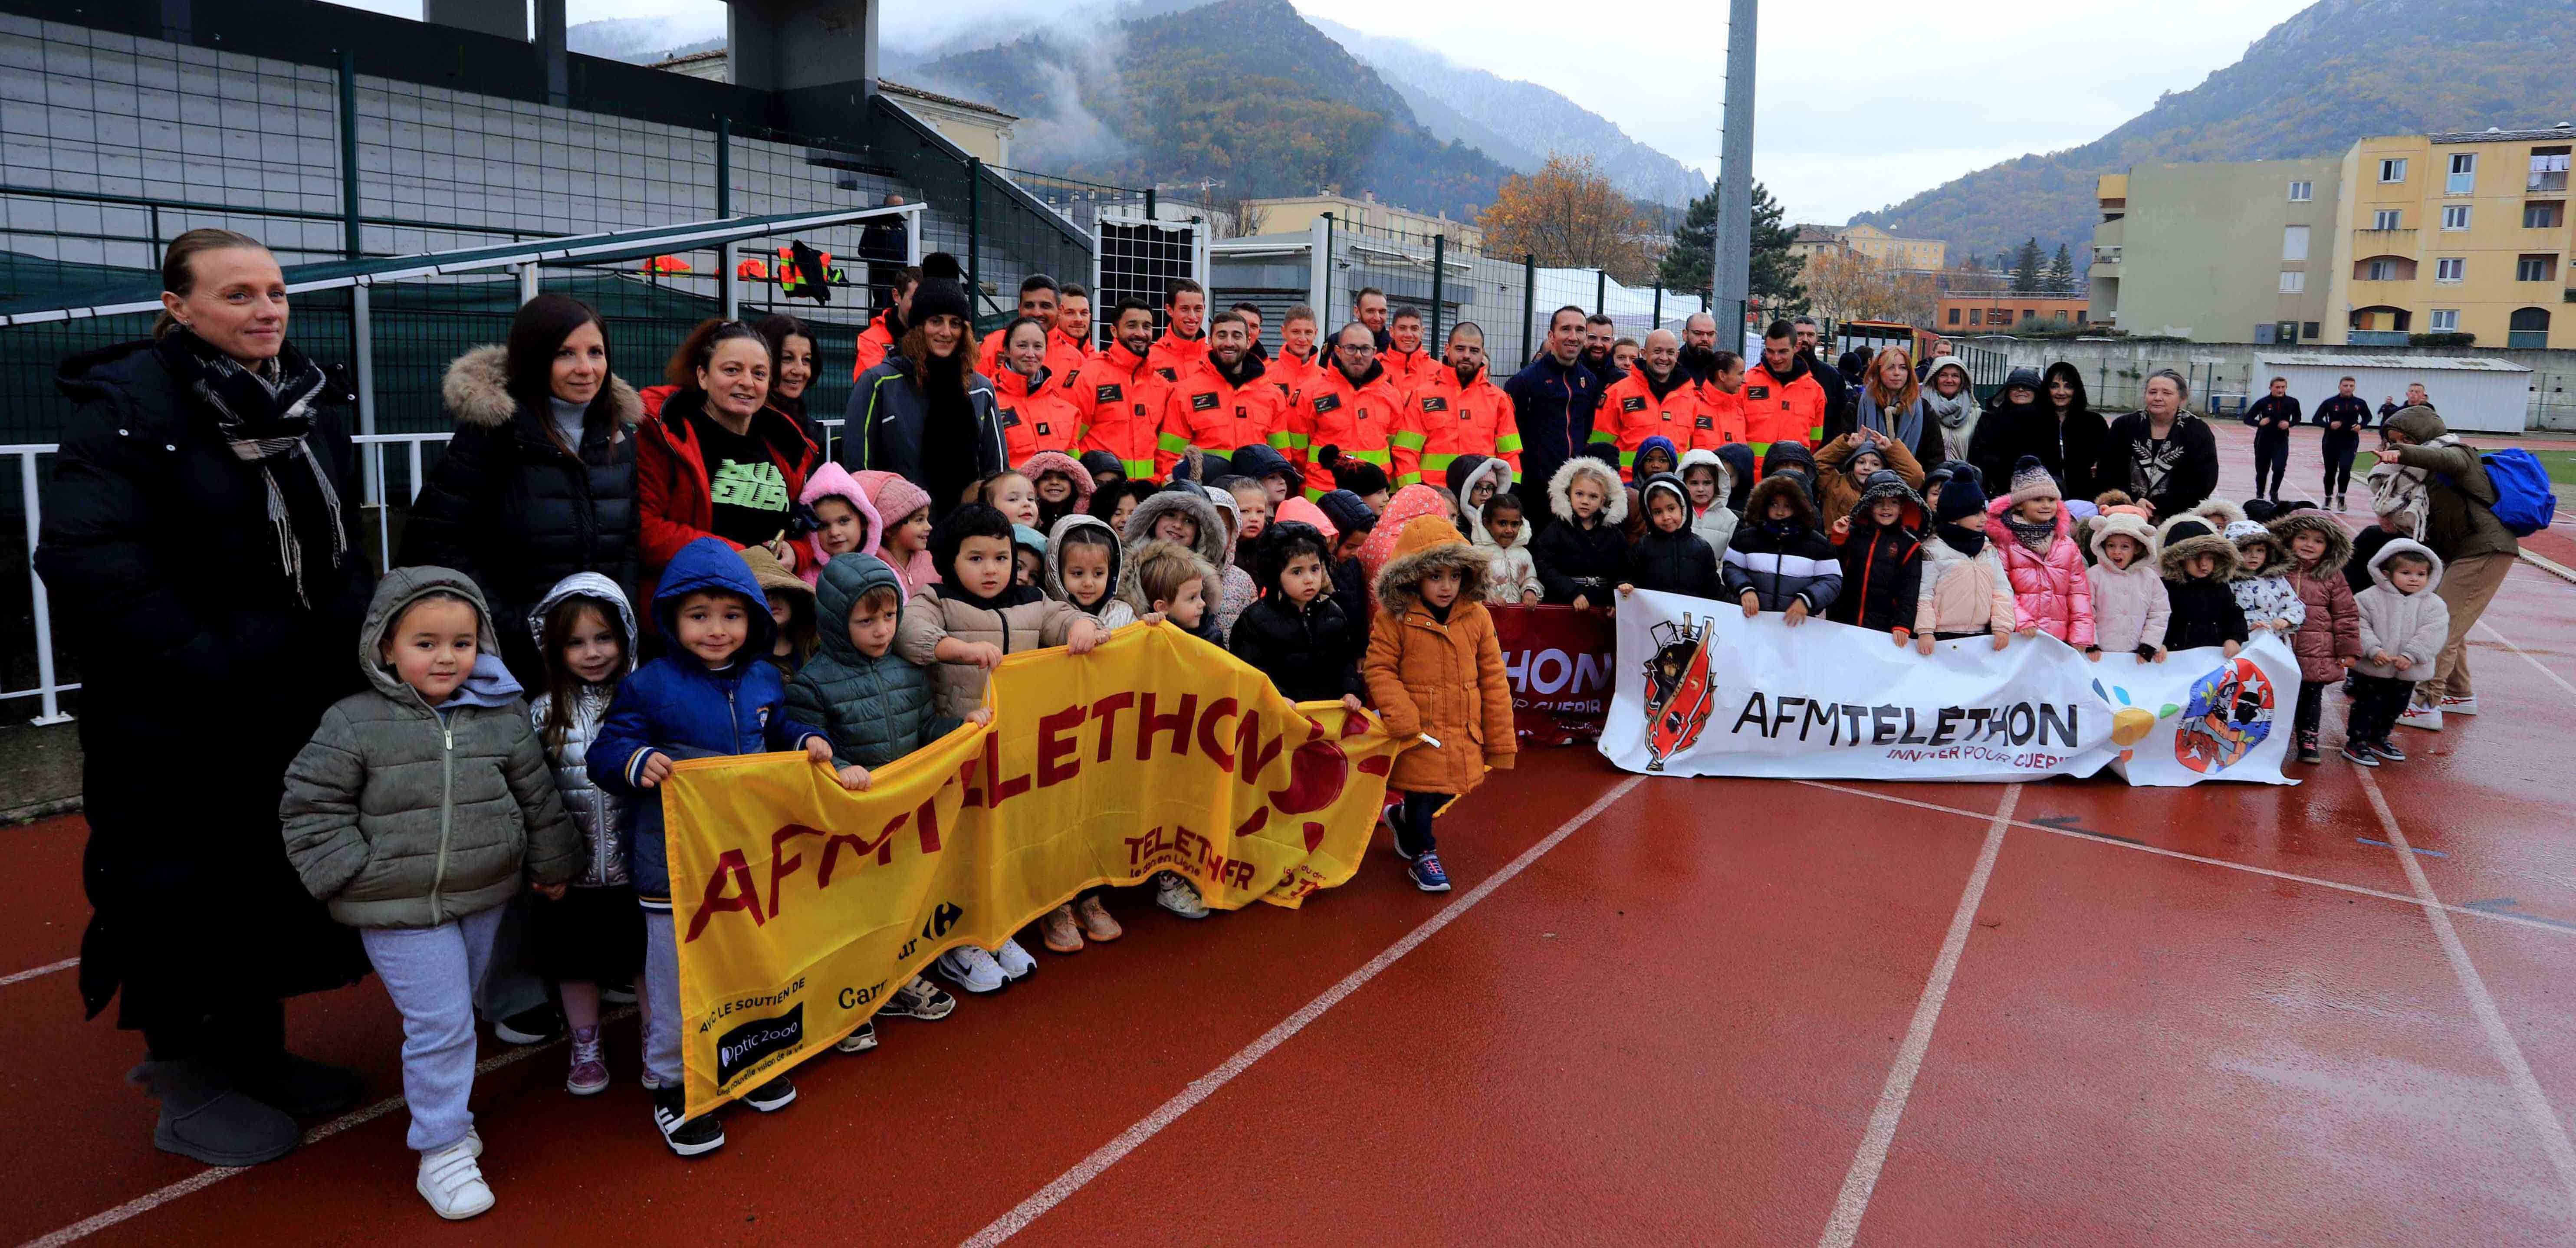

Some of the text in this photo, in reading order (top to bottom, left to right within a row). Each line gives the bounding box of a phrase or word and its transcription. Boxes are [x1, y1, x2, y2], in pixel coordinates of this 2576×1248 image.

[699, 977, 805, 1033] AVC LE SOUTIEN DE
[761, 1022, 797, 1042] 2000
[758, 1058, 775, 1073] vision
[777, 1051, 785, 1061] de
